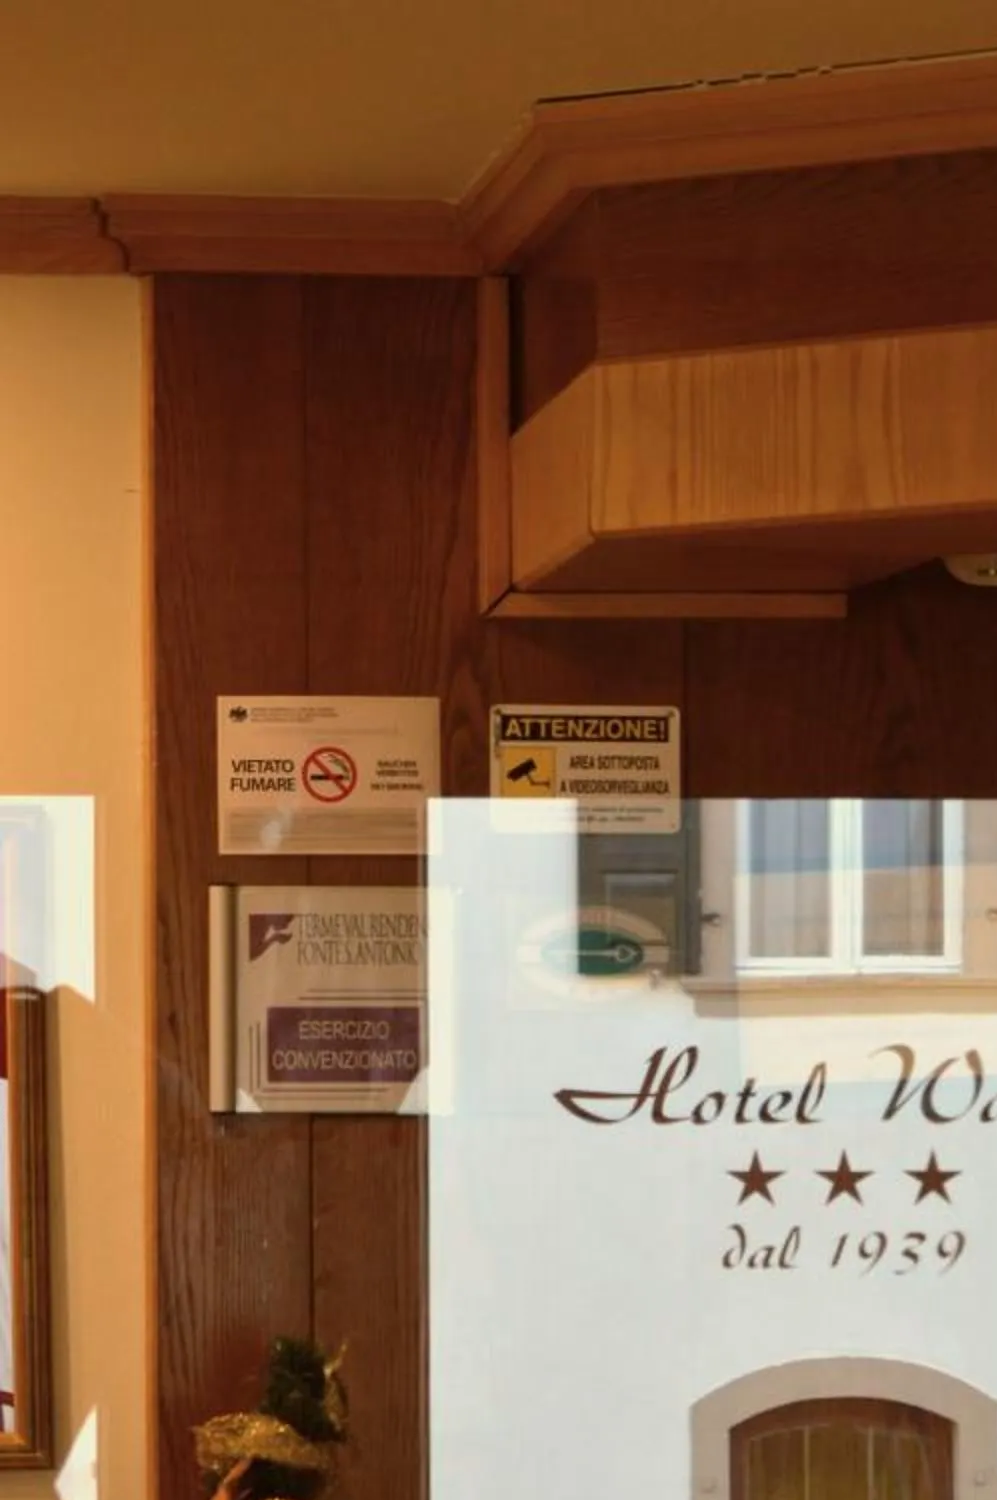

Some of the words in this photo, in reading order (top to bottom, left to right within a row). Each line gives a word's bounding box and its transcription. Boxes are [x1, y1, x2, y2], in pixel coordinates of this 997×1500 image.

[505, 718, 666, 740] ATTENZIONE!
[231, 759, 295, 773] VIETATO
[570, 756, 595, 769] AREA
[598, 756, 660, 769] SOTTOPOSTA
[230, 778, 296, 792] FUMARE
[299, 1020, 390, 1040] ESERCIZIO
[272, 1050, 418, 1070] CONVENZIONATO
[553, 1046, 828, 1125] Hotel
[722, 1223, 801, 1269] dal
[830, 1231, 966, 1278] 1939
